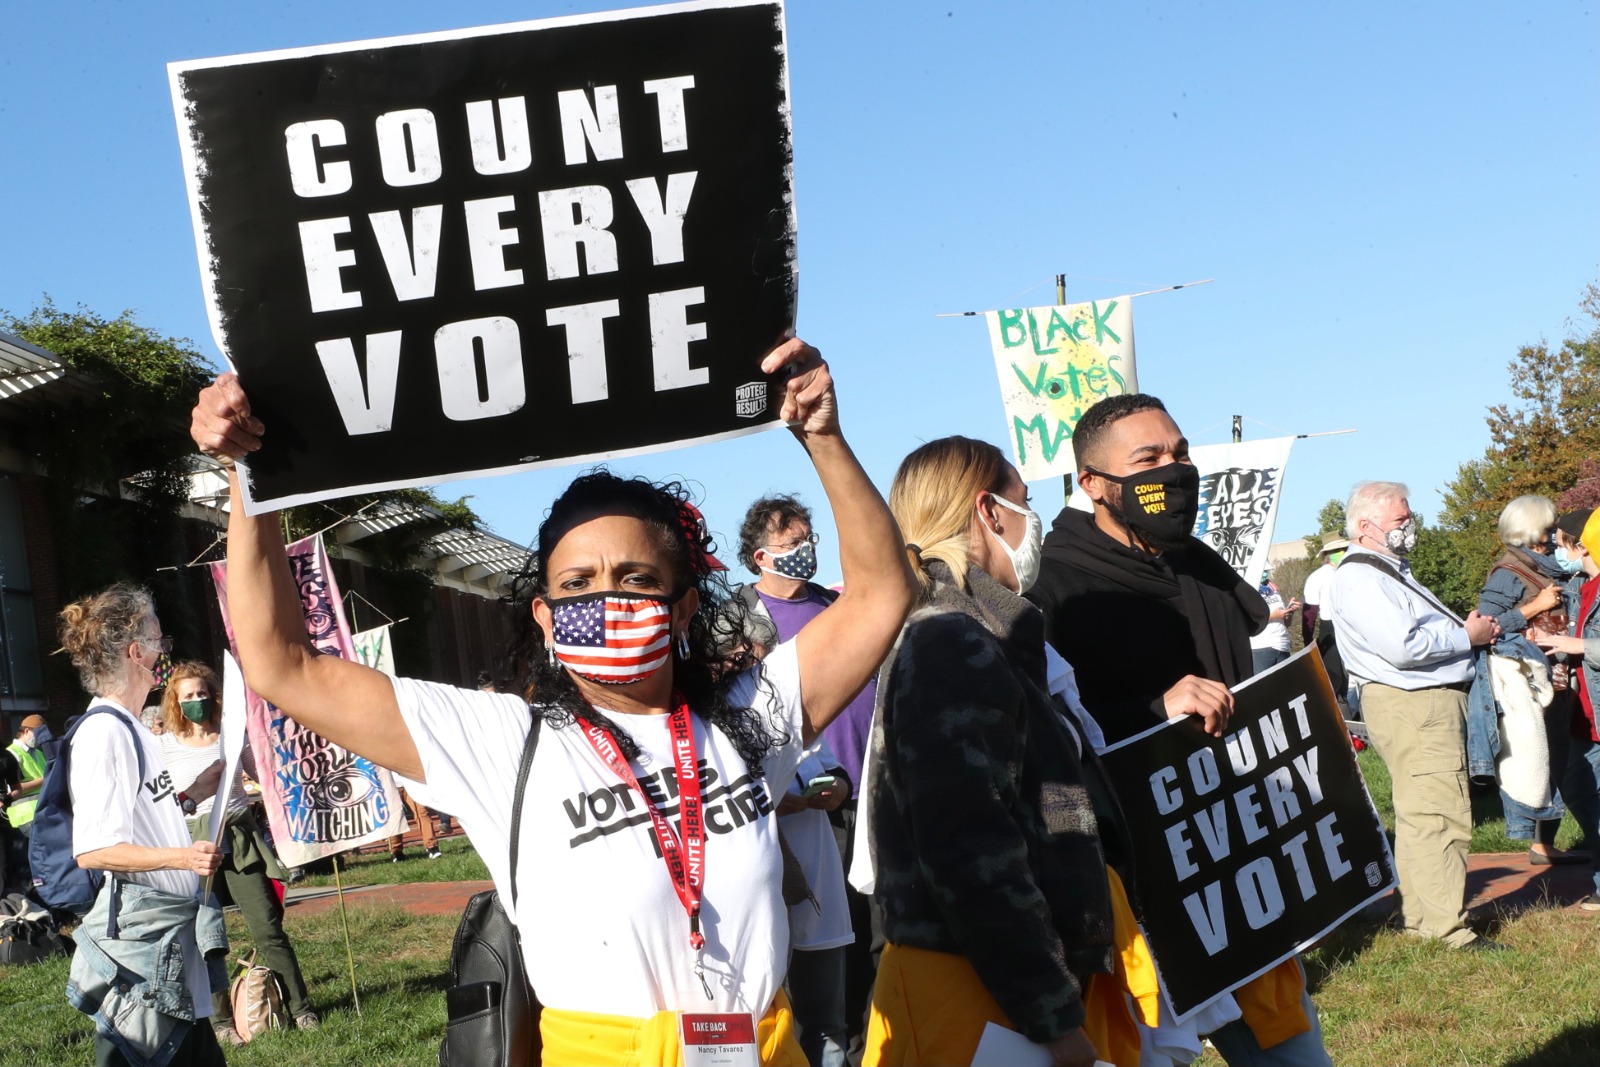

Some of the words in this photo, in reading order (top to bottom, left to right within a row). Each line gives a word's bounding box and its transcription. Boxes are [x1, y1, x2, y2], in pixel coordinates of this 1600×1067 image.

[284, 75, 695, 198] COUNT
[299, 171, 698, 313] EVERY
[315, 286, 710, 436] VOTE
[735, 384, 767, 400] PROTECT
[736, 397, 767, 415] RESULTS
[1134, 484, 1164, 494] COUNT
[1138, 491, 1166, 504] EVERY
[1210, 472, 1272, 505] ALL
[1143, 502, 1166, 514] VOTE
[1206, 496, 1270, 531] EYES
[1148, 693, 1312, 816] COUNT
[300, 784, 316, 807] IS
[284, 791, 390, 842] WATCHING
[1164, 746, 1324, 882] EVERY
[1182, 811, 1352, 957] VOTE
[692, 1022, 708, 1032] TAKE
[710, 1022, 727, 1032] BACK
[698, 1046, 717, 1054] Nancy
[719, 1045, 744, 1053] Tavarez
